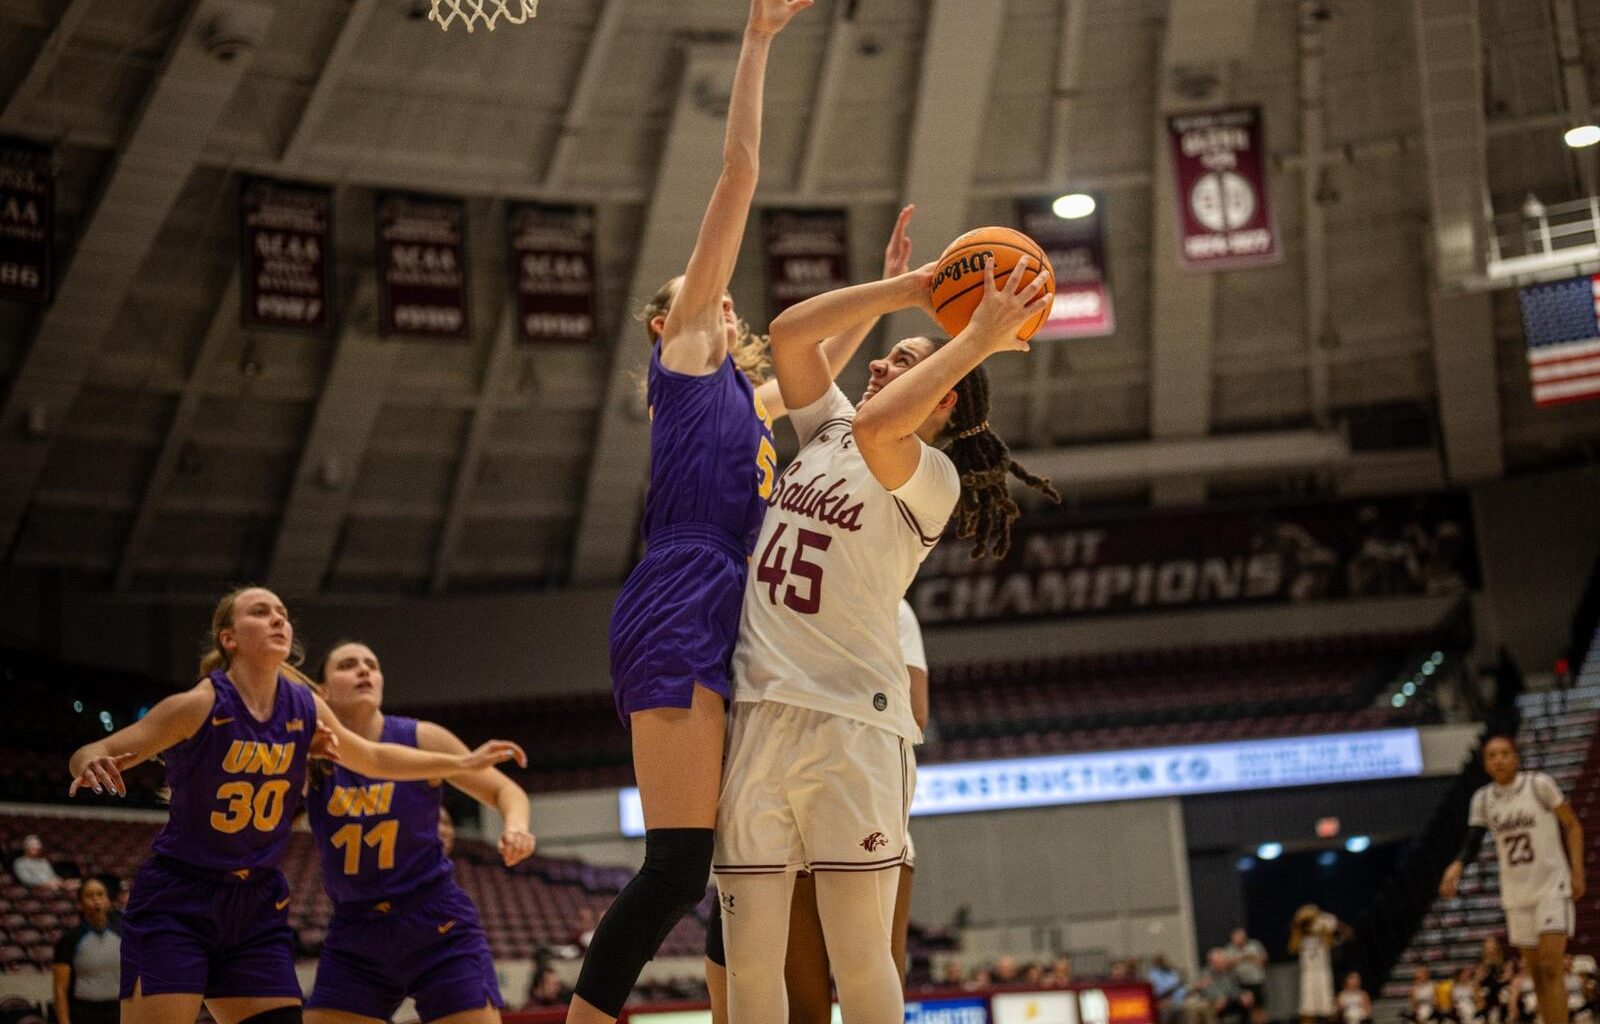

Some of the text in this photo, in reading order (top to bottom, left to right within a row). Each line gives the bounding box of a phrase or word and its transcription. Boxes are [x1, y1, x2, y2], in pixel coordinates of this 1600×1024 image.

[767, 461, 864, 531] Salukis
[757, 522, 832, 614] 45
[914, 552, 1283, 623] CHAMPIONS
[222, 739, 296, 775] UNI
[210, 779, 290, 834] 30
[327, 781, 395, 817] UNI
[330, 819, 399, 875] 11
[1505, 833, 1535, 867] 23
